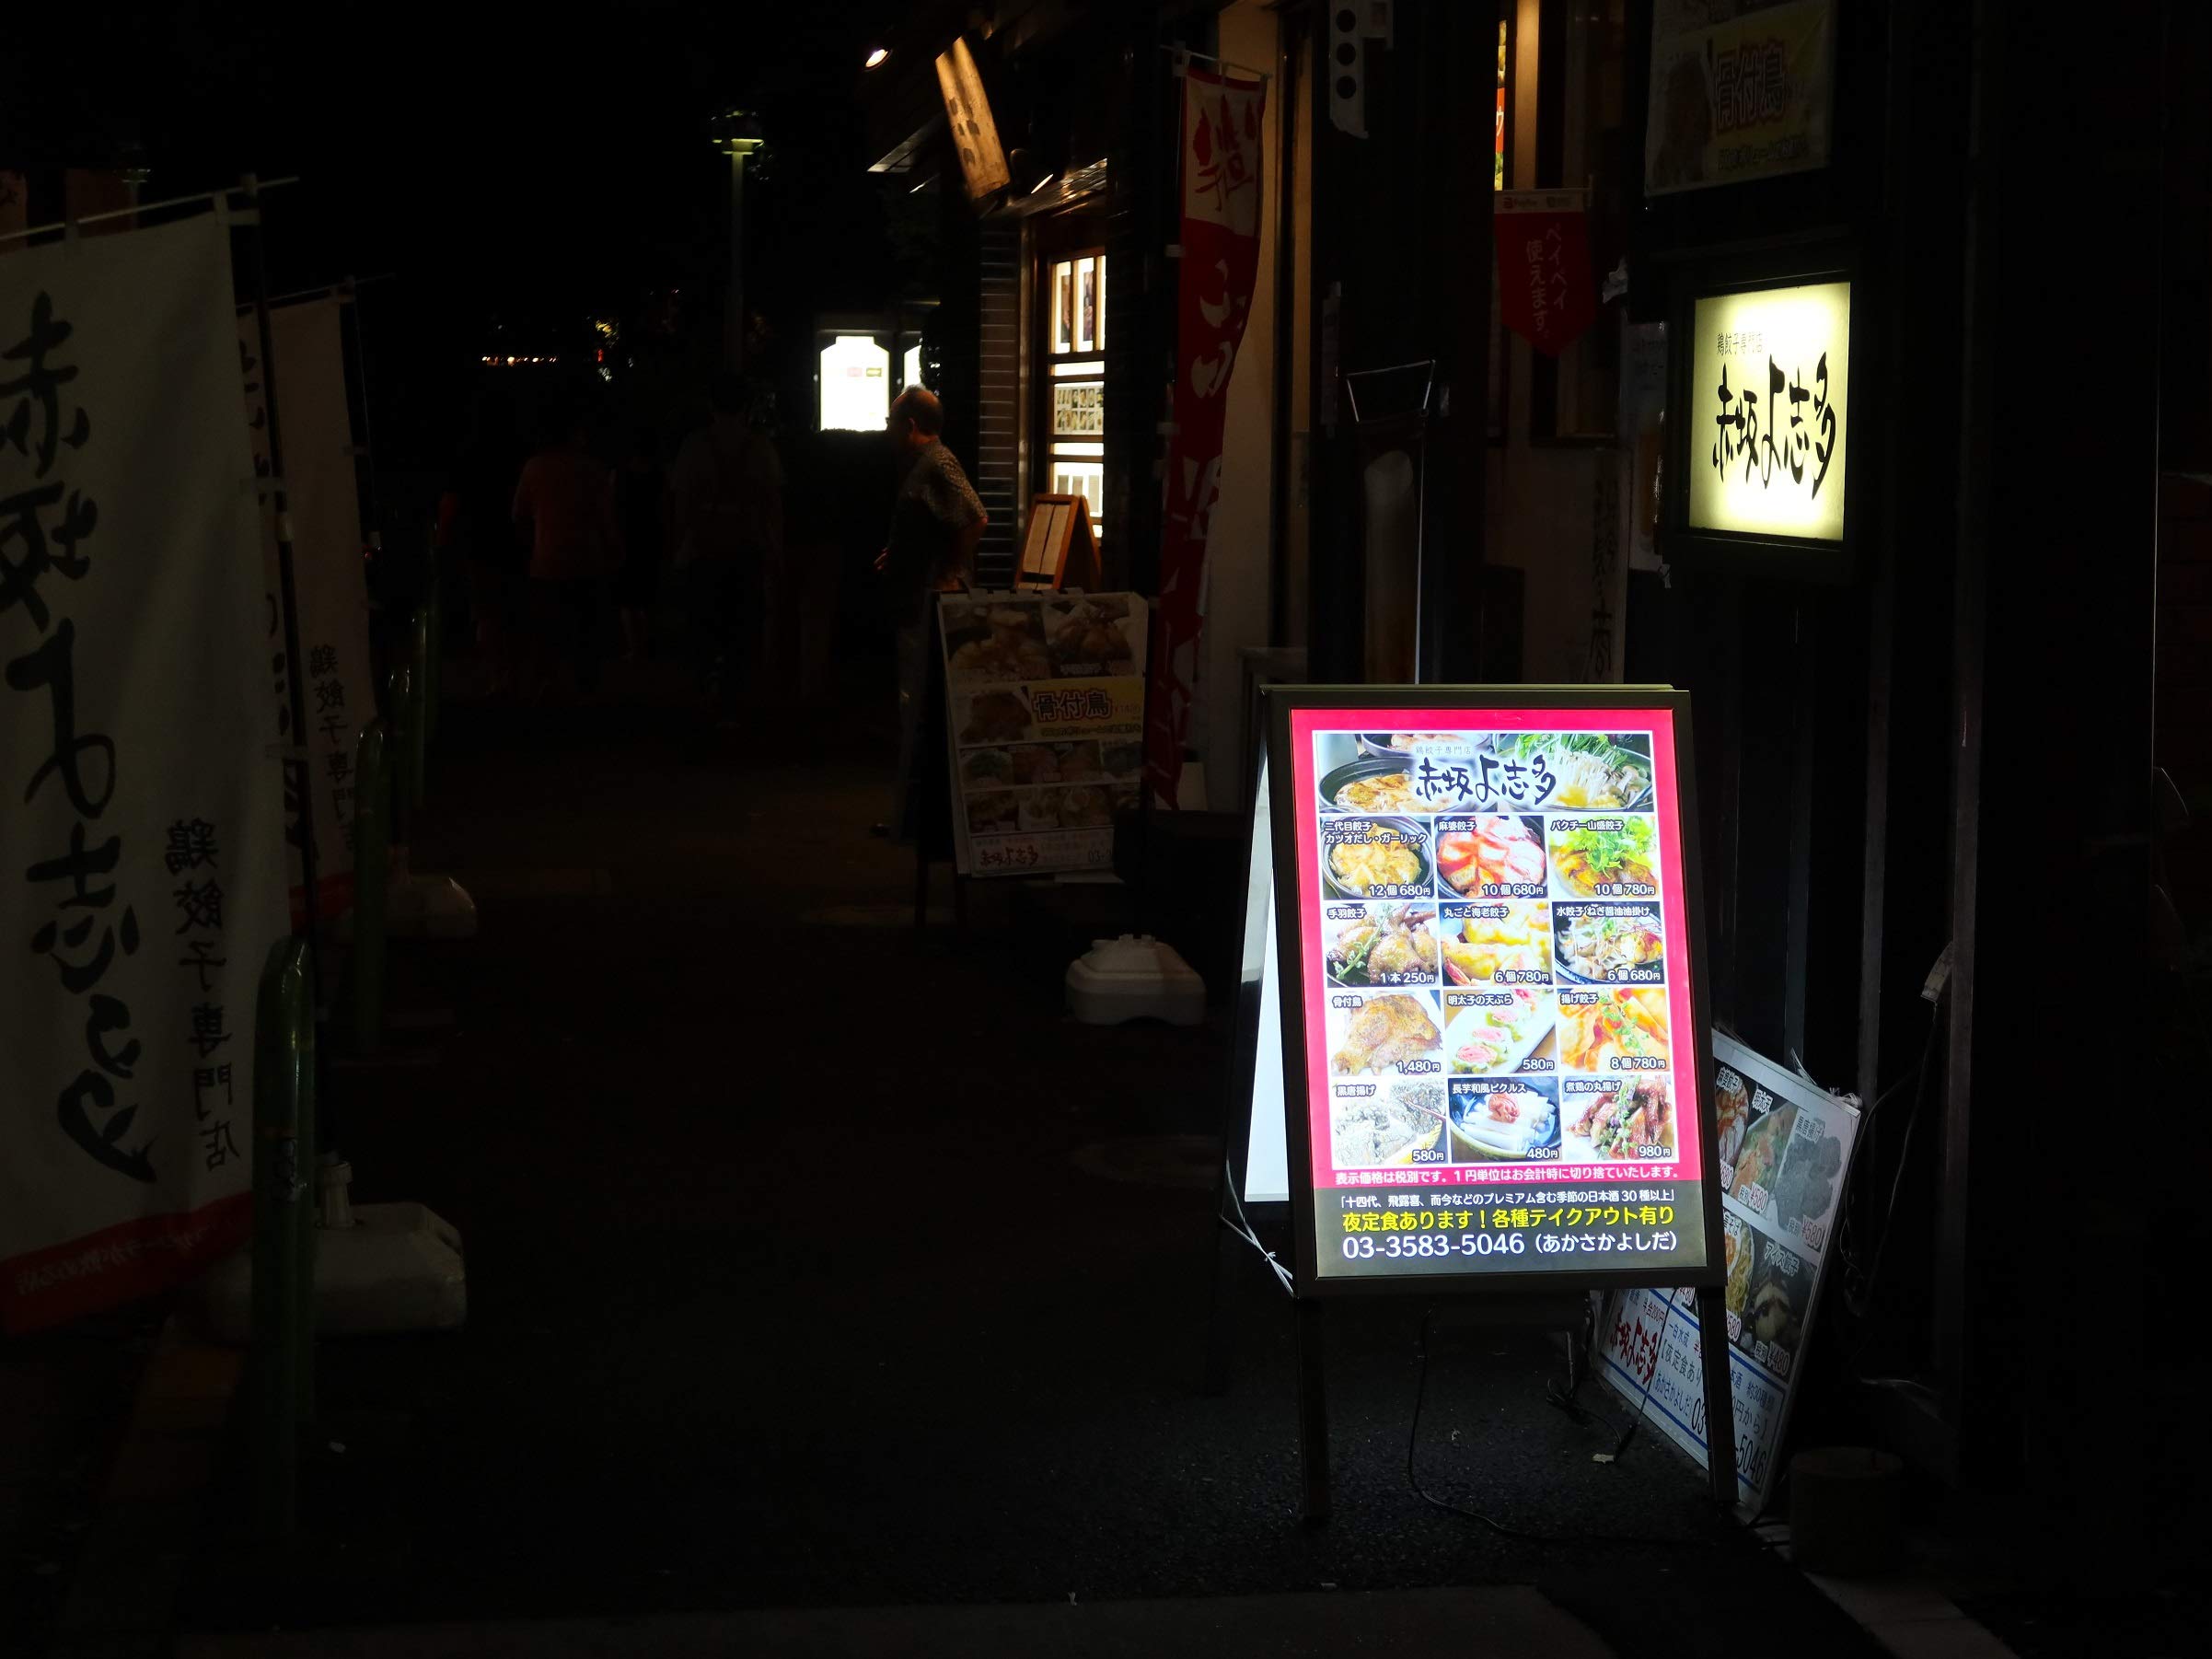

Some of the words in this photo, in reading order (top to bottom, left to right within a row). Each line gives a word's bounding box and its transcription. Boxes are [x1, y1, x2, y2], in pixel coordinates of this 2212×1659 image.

[1546, 222, 1569, 310] ペイペイ
[1712, 351, 1837, 499] 赤坂よ志多
[1415, 745, 1472, 756] 鶏餃子専門店
[1416, 754, 1558, 806] 赤坂よ志多
[1439, 820, 1477, 832] 麻婆餃子
[1551, 819, 1624, 831] パクチー山盛餃子
[1326, 832, 1428, 845] カツオだし・ガーリック
[1327, 907, 1366, 919] 手羽餃子
[1443, 906, 1509, 919] 丸ごと海老餃子
[1333, 995, 1362, 1008] 骨付鳥
[1448, 992, 1513, 1006] 明太子の天ぷら
[1560, 992, 1599, 1004] 揚げ餃子
[1396, 1060, 1441, 1073] 1,480円
[1522, 1058, 1555, 1072] 580円
[1452, 1081, 1527, 1095] 長芋和風ピクルス
[1411, 1148, 1444, 1162] 580円
[1526, 1146, 1559, 1160] 480円
[1638, 1143, 1672, 1157] 980円
